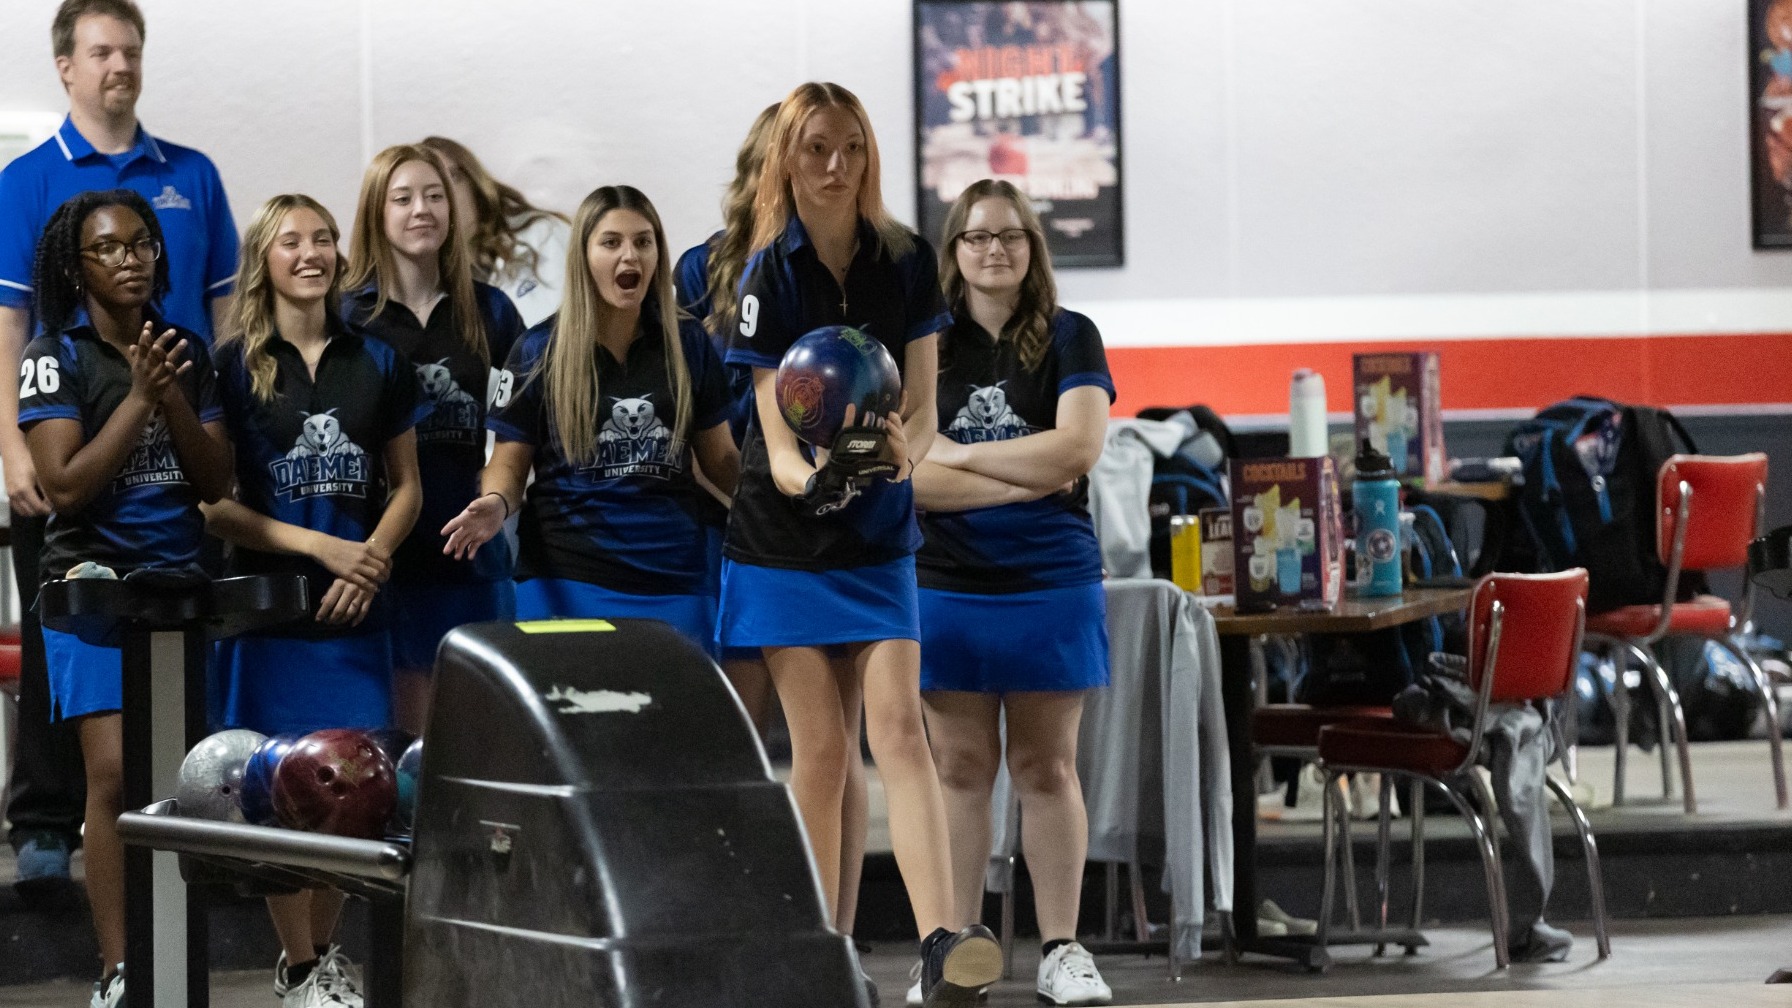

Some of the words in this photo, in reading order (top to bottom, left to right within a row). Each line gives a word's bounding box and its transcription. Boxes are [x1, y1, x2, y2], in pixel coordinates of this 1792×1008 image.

[947, 71, 1088, 122] STRIKE
[740, 294, 760, 338] 9
[20, 356, 60, 399] 26
[492, 368, 514, 408] 3
[846, 440, 877, 449] STORM
[604, 464, 661, 478] UNIVERSITY
[858, 465, 895, 475] UNIVERSAL
[1243, 463, 1306, 483] COCKTAILS
[301, 482, 354, 496] UNIVERSITY
